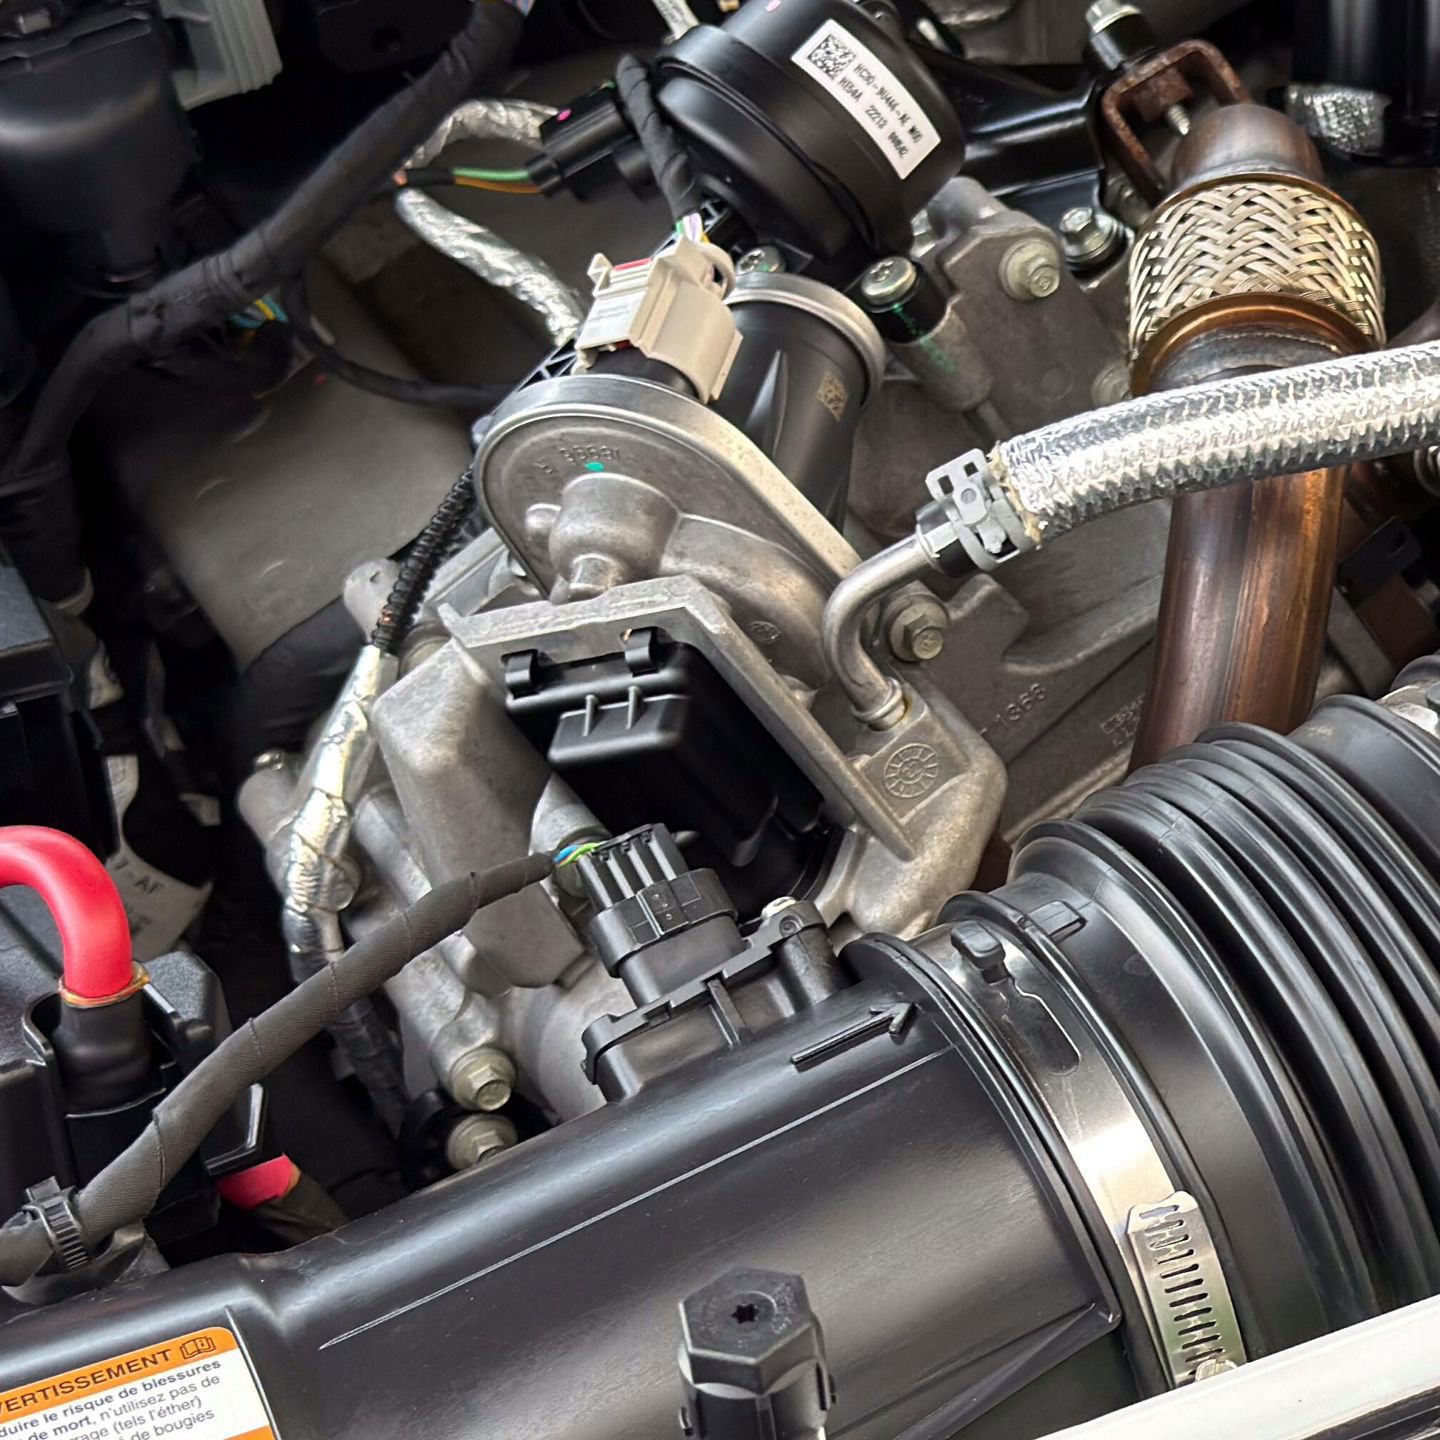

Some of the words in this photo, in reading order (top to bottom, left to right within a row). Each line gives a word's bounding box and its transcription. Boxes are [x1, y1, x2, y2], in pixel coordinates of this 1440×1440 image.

[42, 1409, 59, 1425] le
[61, 1391, 115, 1419] risque
[116, 1384, 140, 1402] de
[141, 1357, 223, 1394] blessures
[51, 1412, 97, 1438] mort,
[98, 1390, 166, 1423] n'utilisez
[168, 1380, 199, 1401] pas
[199, 1373, 222, 1391] de
[111, 1412, 147, 1435] (tels
[147, 1394, 204, 1423] l'éther)
[153, 1407, 216, 1438] bougies
